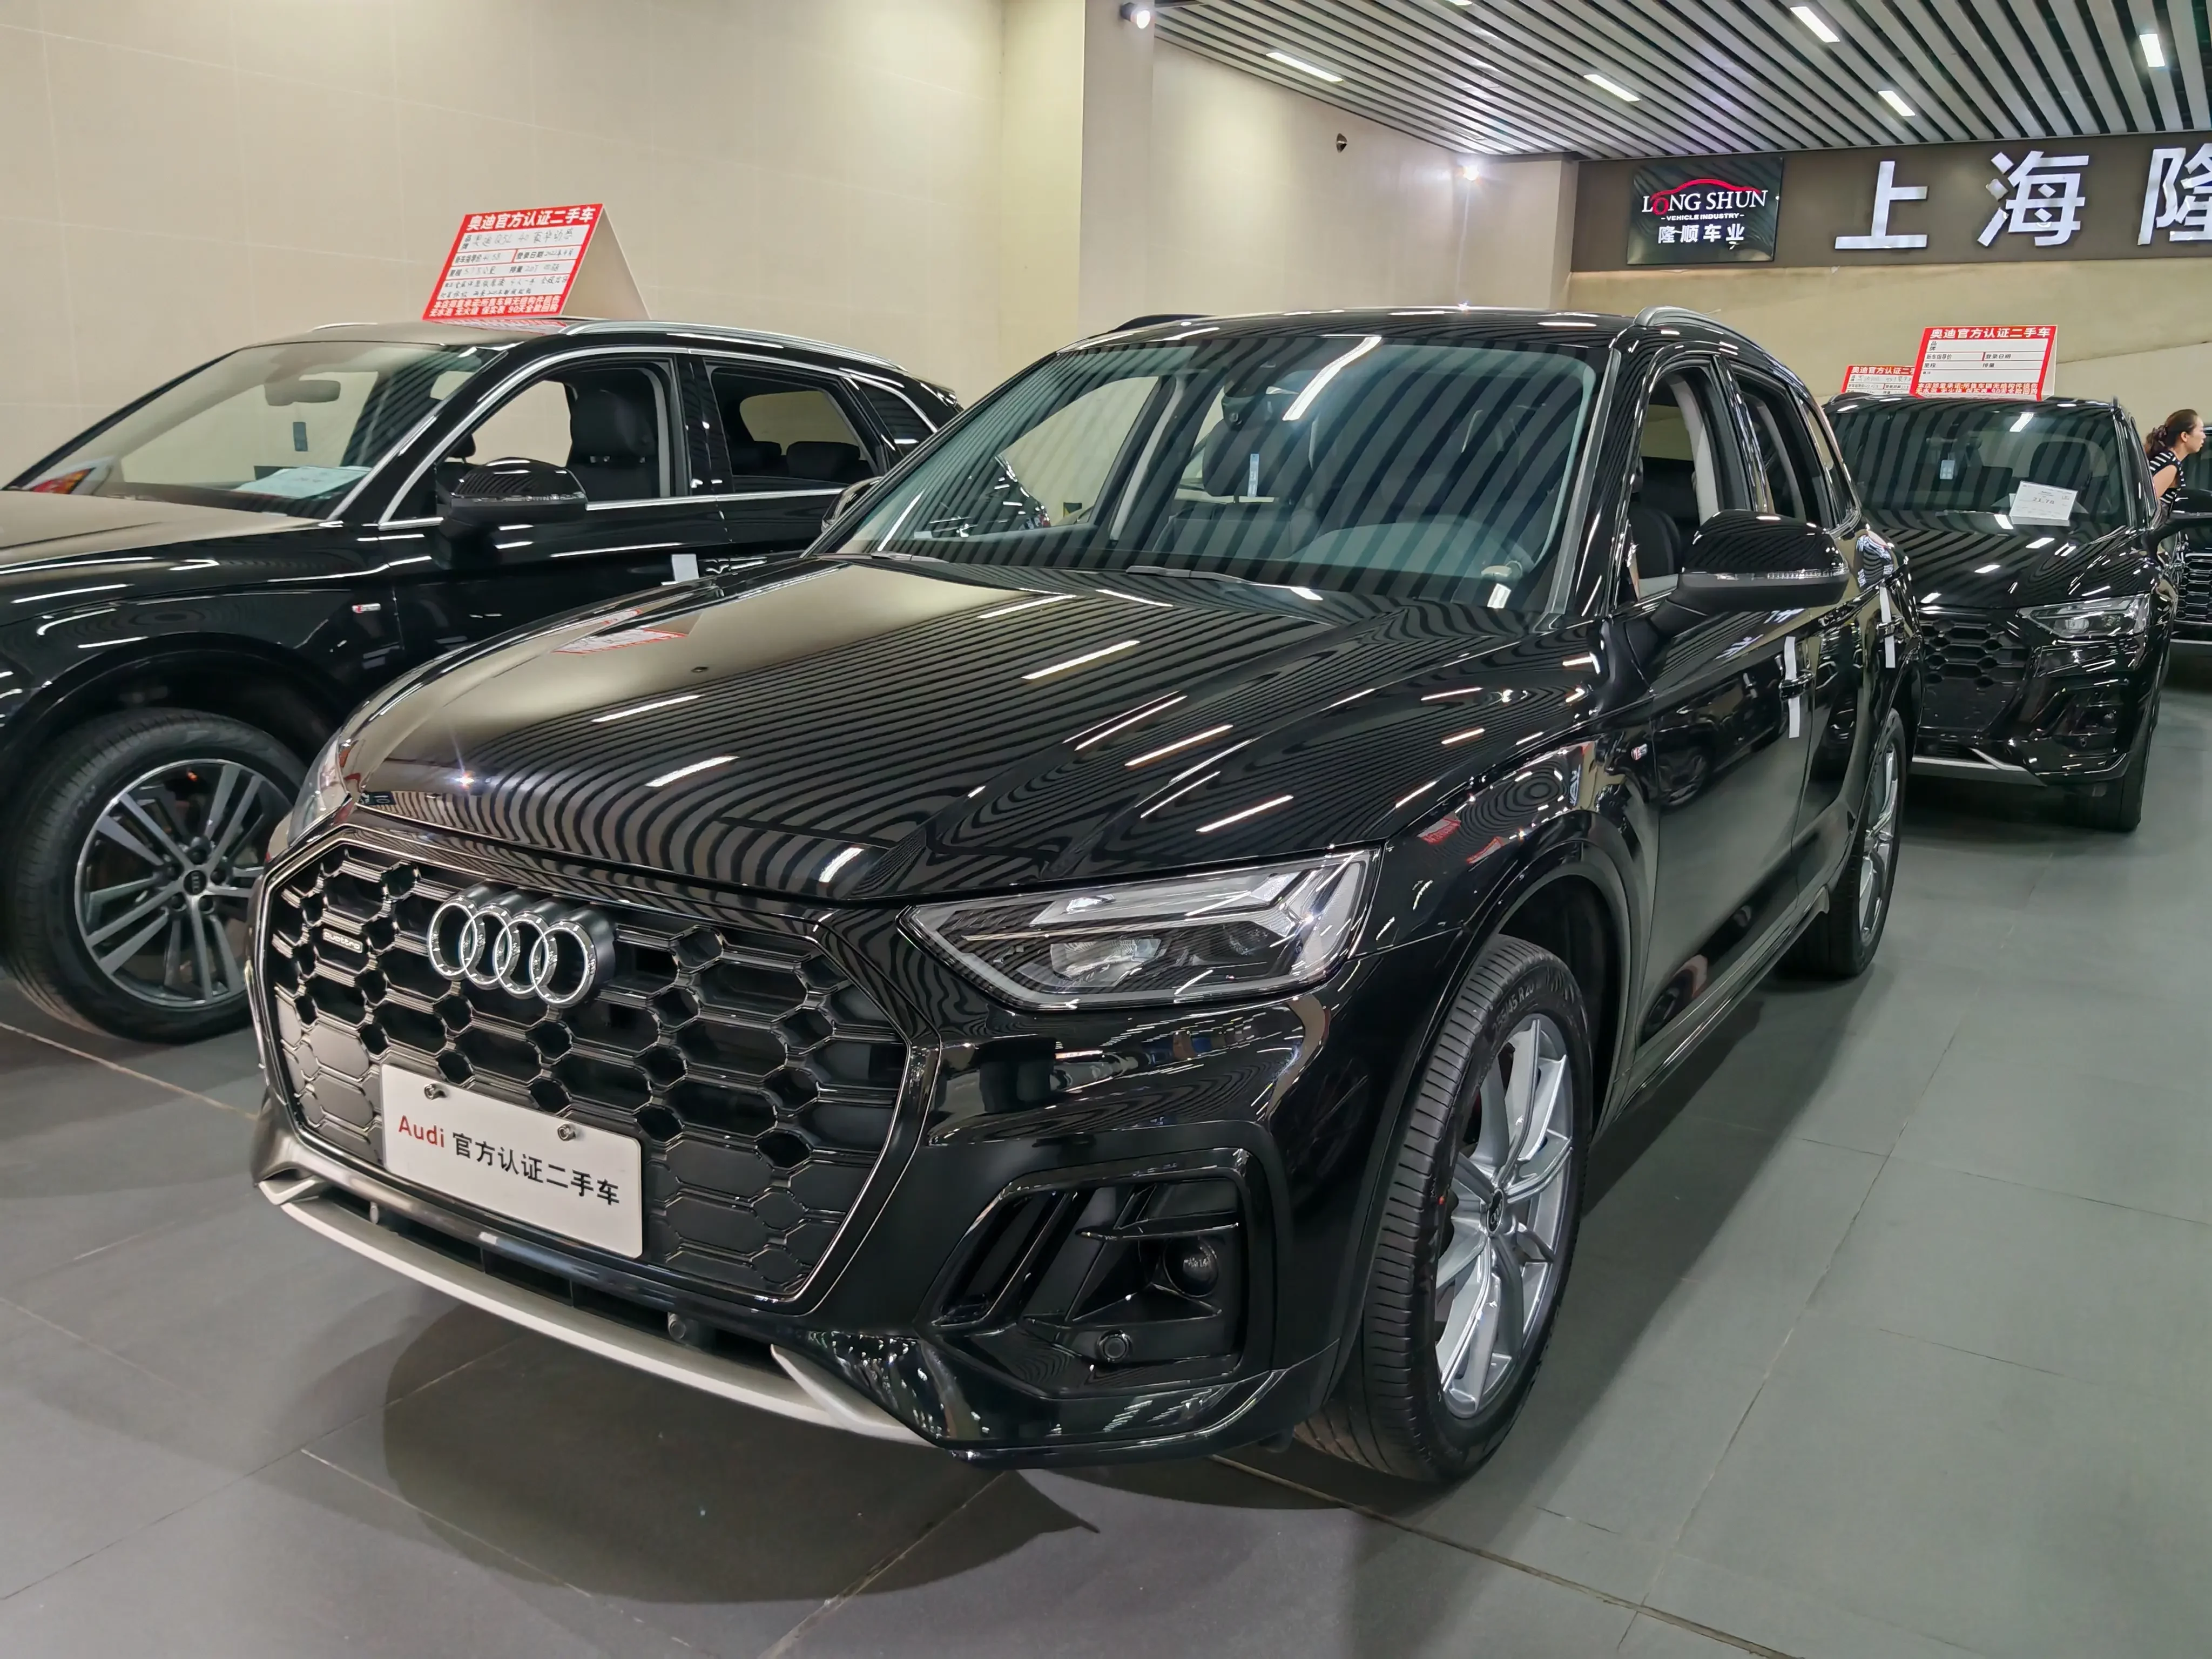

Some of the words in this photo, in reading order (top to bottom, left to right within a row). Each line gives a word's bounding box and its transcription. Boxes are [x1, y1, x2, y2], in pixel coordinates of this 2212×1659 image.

[1642, 193, 1701, 215] LONG
[1706, 190, 1769, 210] SHUN
[467, 208, 595, 231] 奥迪官方认证二手车
[1658, 223, 1745, 244] 隆顺车业
[1930, 327, 2051, 340] 奥迪官方认证二手车
[323, 932, 360, 950] quattro
[398, 1115, 445, 1148] Audi
[453, 1132, 621, 1206] 官方认证二手车
